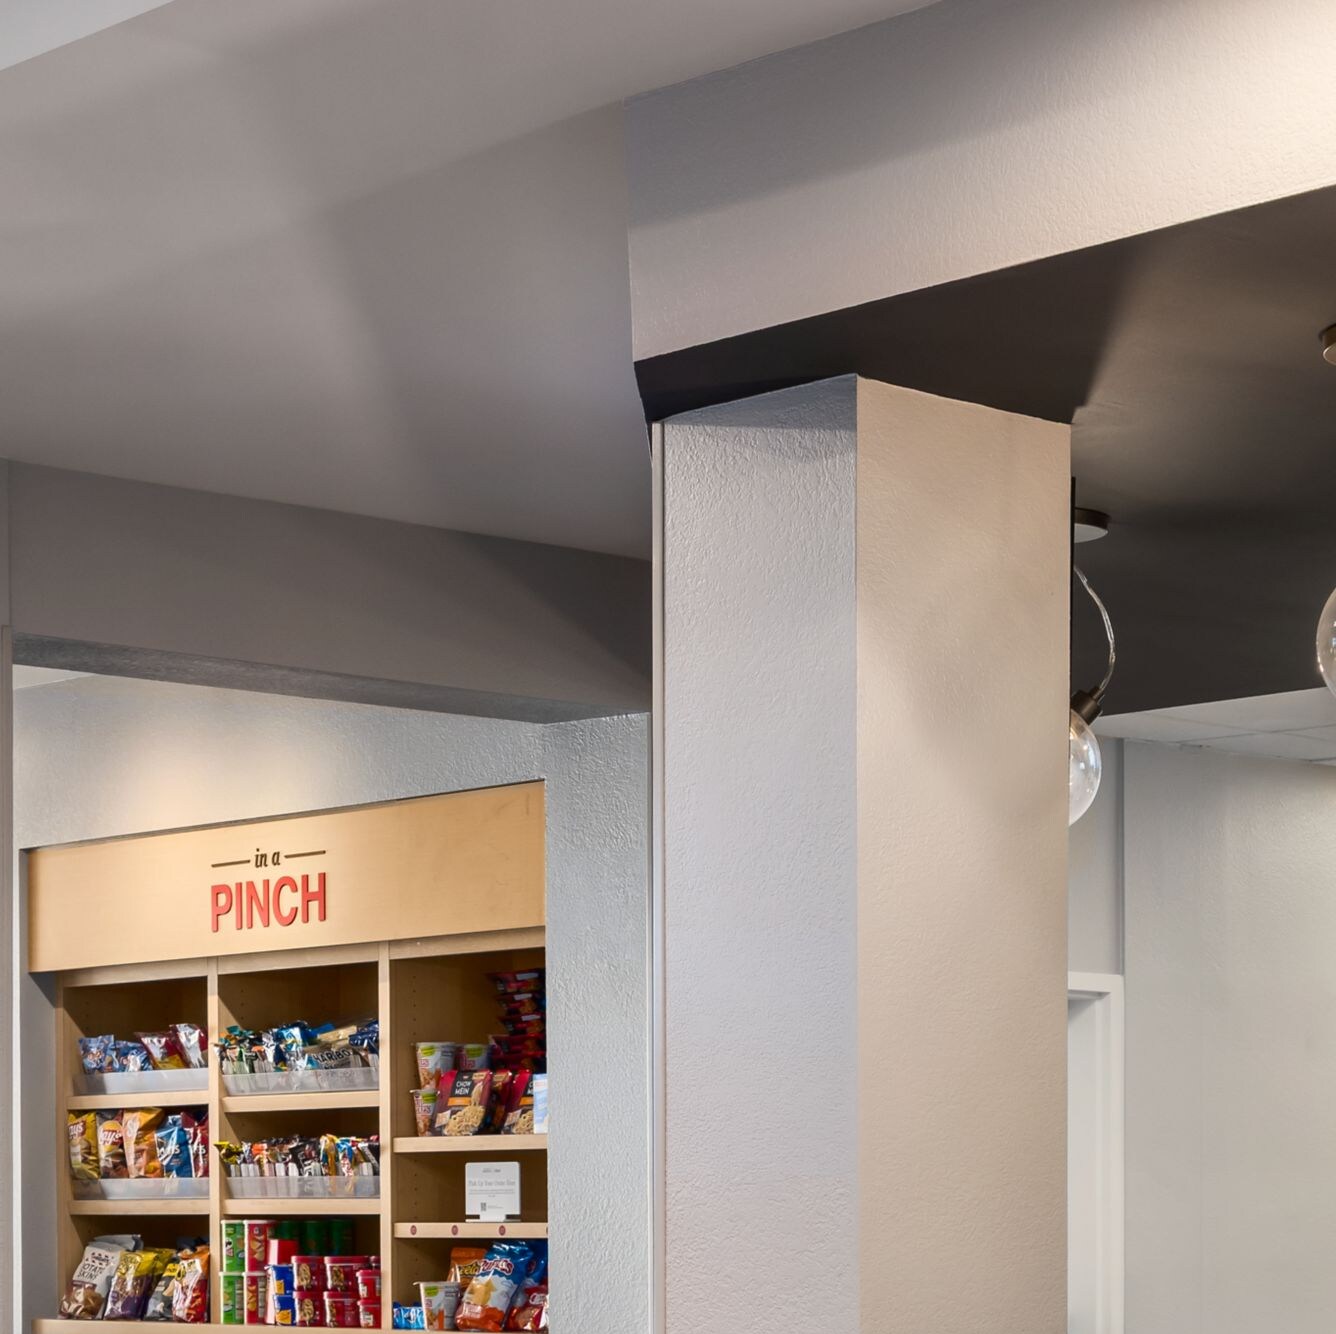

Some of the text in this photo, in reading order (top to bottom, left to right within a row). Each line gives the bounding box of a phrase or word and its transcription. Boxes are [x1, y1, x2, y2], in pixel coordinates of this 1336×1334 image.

[254, 848, 281, 869] in a
[210, 872, 327, 933] PINCH
[312, 1048, 353, 1063] HARIBO
[454, 1087, 470, 1096] MEIN
[456, 1080, 472, 1088] CHOW
